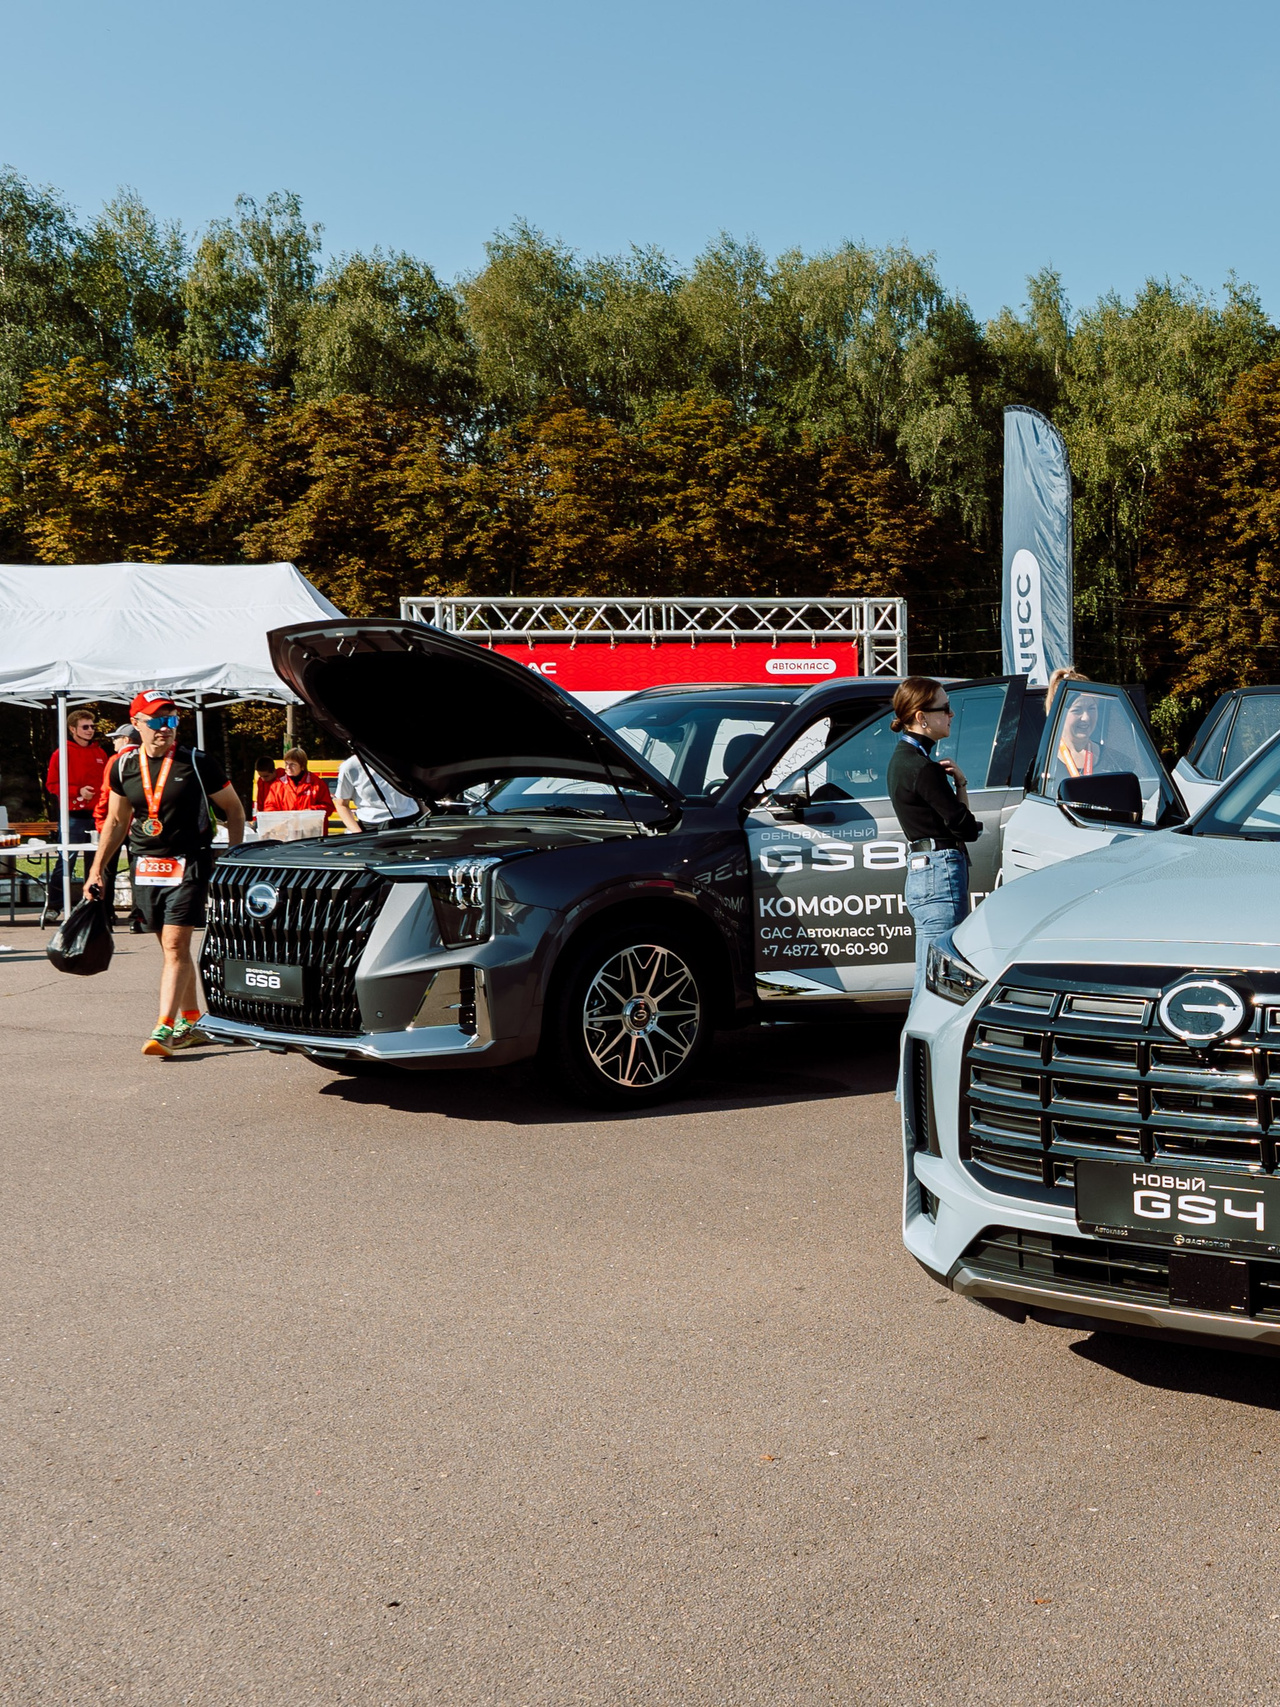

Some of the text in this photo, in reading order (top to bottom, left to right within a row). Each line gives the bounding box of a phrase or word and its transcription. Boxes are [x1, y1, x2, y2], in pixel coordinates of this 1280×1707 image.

[524, 662, 557, 675] AC
[772, 662, 830, 670] АВТОКЛАСС
[760, 827, 876, 841] ОБНОВЛЕННЫЙ
[760, 841, 907, 874] GS8
[147, 862, 173, 873] 2333
[759, 894, 908, 918] КОМФОРТН
[760, 924, 912, 940] GAC Автокласс Тула
[762, 942, 889, 958] +7 4872 70-60-90
[245, 973, 281, 990] GS8
[1132, 1172, 1206, 1192] НОВЫЙ
[1132, 1190, 1265, 1232] GS4
